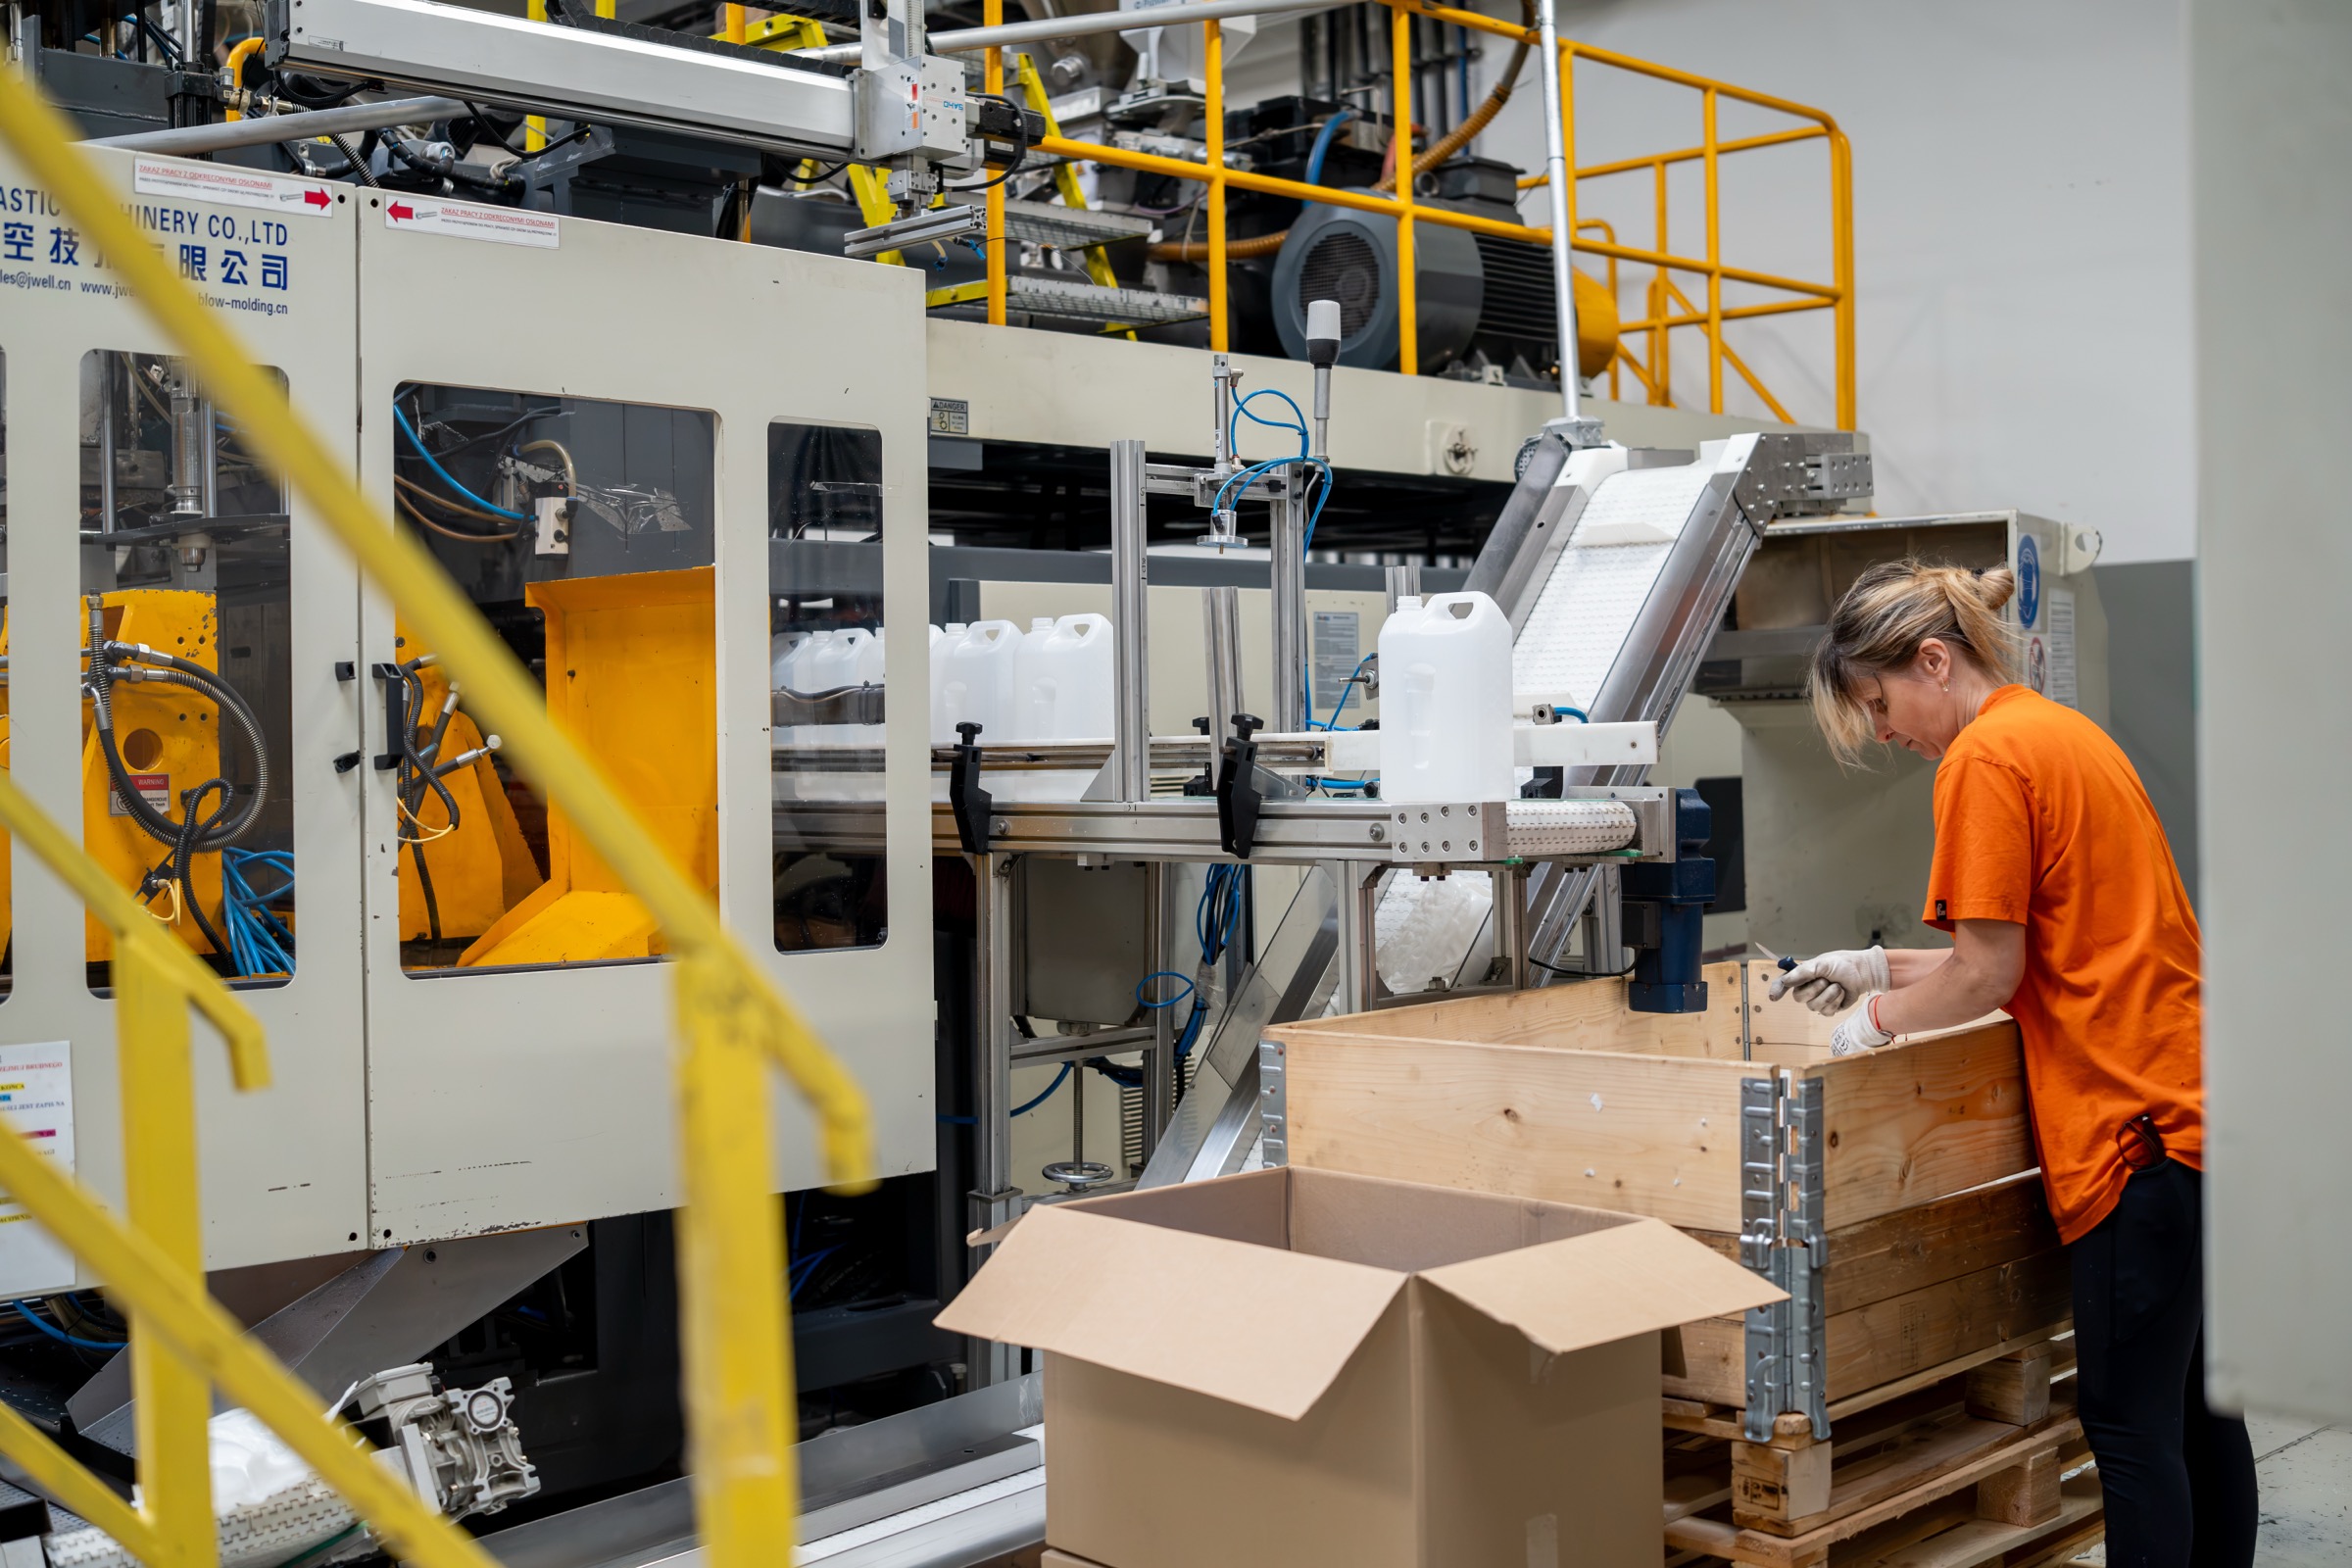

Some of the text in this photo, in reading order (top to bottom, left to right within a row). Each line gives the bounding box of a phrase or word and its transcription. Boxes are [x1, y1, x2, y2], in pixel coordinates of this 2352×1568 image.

[139, 165, 160, 173] ZAKAZ
[162, 168, 182, 176] PRACY
[441, 207, 459, 216] ZAKAZ
[120, 203, 199, 235] HINERY
[208, 214, 287, 246] CO.,LTD
[80, 280, 137, 299] www.jwe
[939, 401, 965, 412] DANGER
